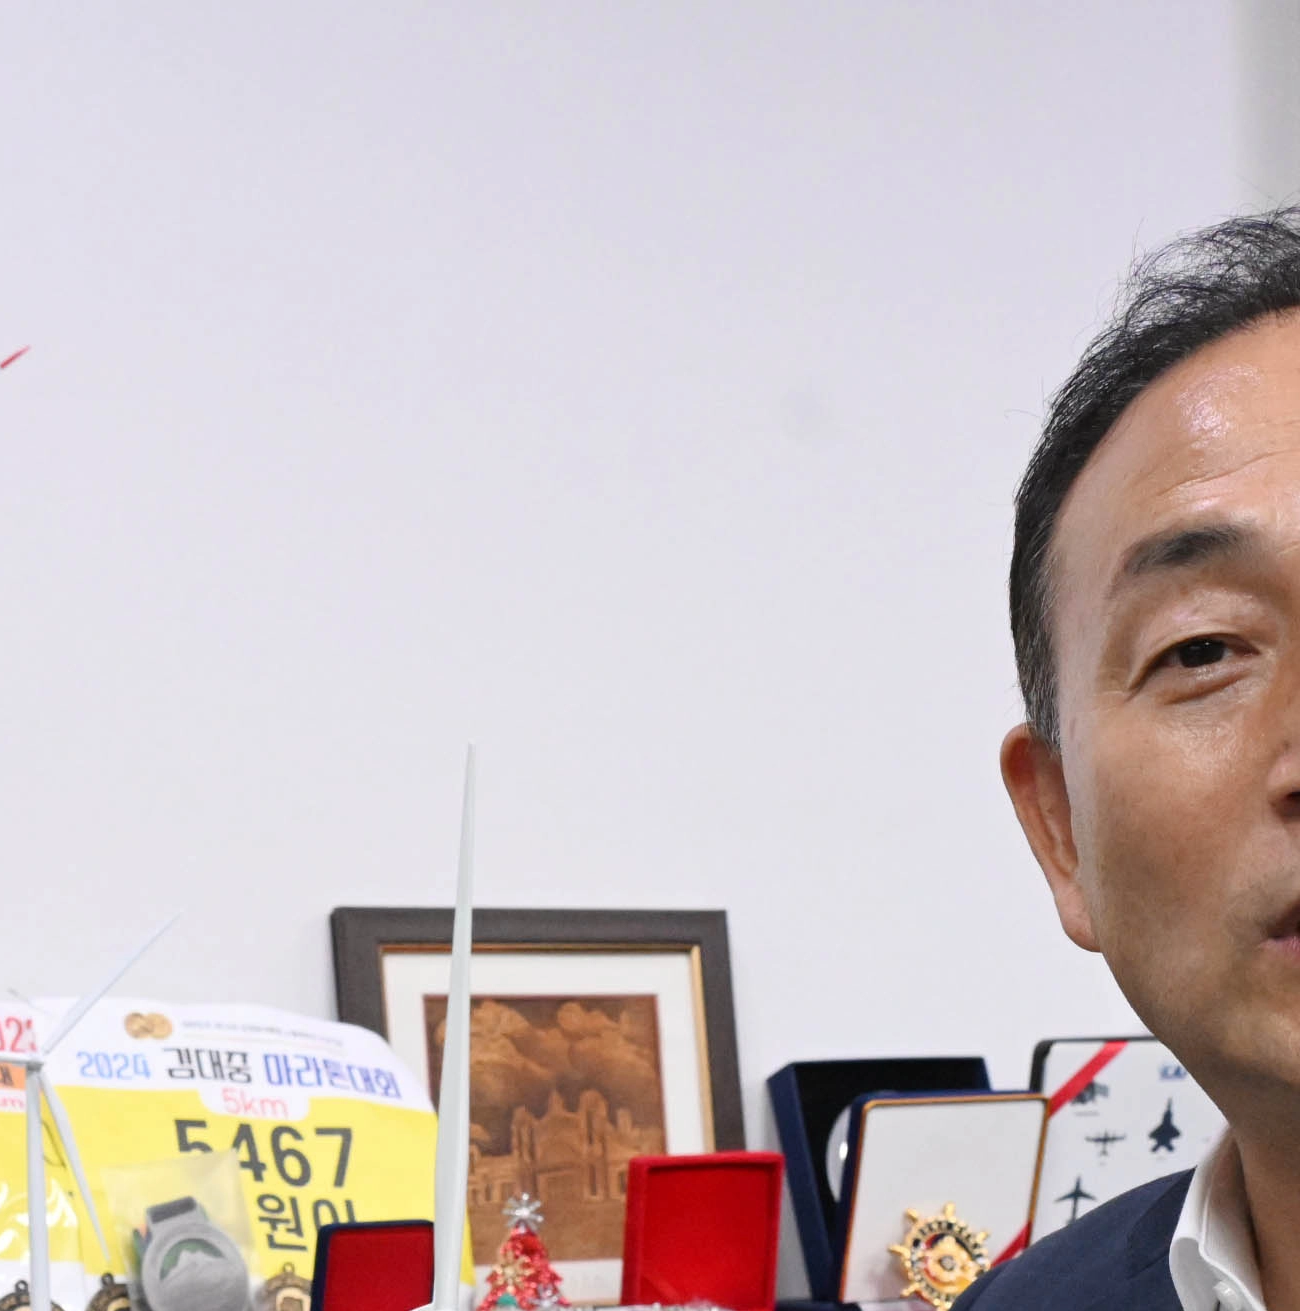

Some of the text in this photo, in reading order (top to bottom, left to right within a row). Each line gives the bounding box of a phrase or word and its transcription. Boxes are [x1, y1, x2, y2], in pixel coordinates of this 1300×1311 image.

[76, 1050, 152, 1081] 2024
[163, 1047, 252, 1084] 김대중
[222, 1088, 288, 1119] 5km
[174, 1119, 352, 1188] 5467
